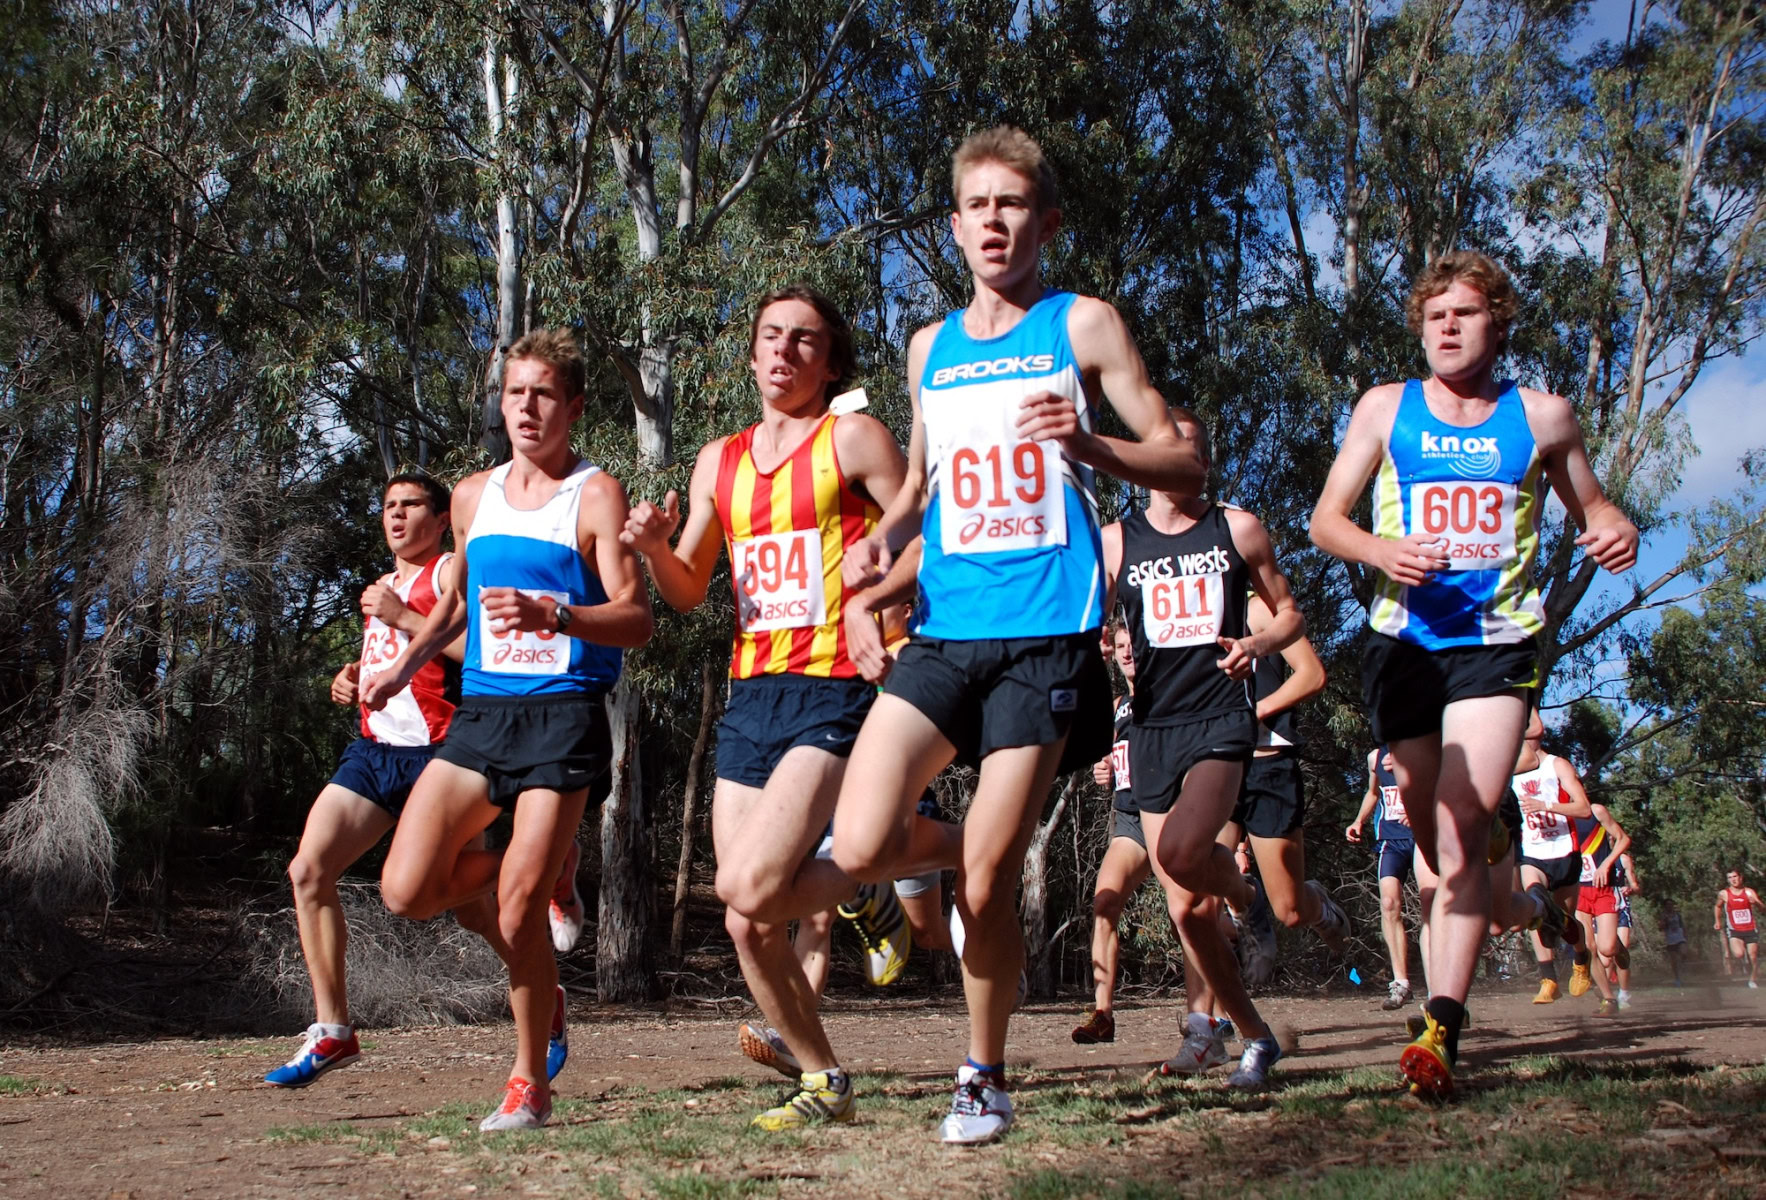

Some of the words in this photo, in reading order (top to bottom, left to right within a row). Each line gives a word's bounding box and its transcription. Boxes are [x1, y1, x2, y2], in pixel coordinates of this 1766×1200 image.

[931, 354, 1055, 386] BROOKS
[1421, 431, 1498, 453] knox
[952, 441, 1046, 509] 619
[1422, 485, 1504, 535] 603
[987, 515, 1045, 539] asics
[1451, 543, 1501, 559] asics
[743, 536, 809, 597] 594
[1127, 556, 1174, 587] asics
[1178, 545, 1231, 577] wests
[764, 600, 809, 621] asics
[1151, 577, 1213, 622] 611
[1176, 622, 1214, 639] asics
[512, 648, 556, 664] asics
[1112, 744, 1126, 772] 57
[1384, 788, 1399, 807] 57
[1526, 810, 1557, 831] 610
